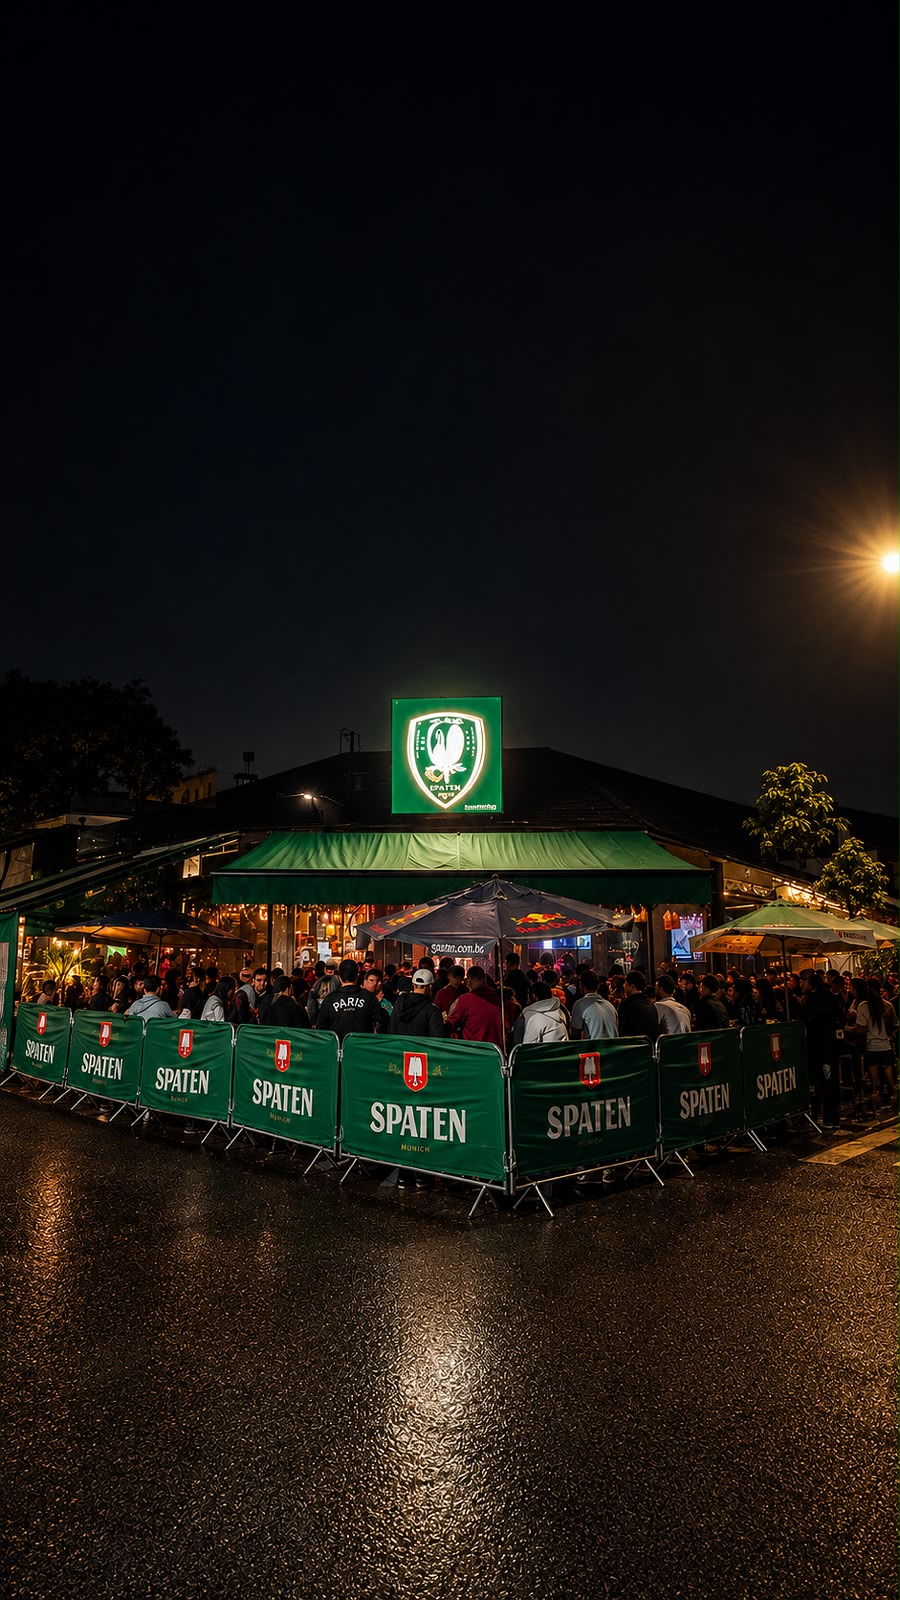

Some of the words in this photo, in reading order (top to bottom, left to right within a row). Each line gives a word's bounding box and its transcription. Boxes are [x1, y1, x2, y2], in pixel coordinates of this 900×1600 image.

[332, 997, 366, 1012] PARIS
[25, 1039, 55, 1064] SPATEN
[81, 1052, 123, 1080] SPATEN
[155, 1066, 210, 1094] SPATEN
[756, 1066, 797, 1100] SPATEN
[252, 1078, 314, 1118] SPATEN
[679, 1082, 730, 1120] SPATEN
[370, 1102, 466, 1144] SPATEN
[546, 1096, 631, 1140] SPATEN
[401, 1144, 430, 1152] MUNICH
